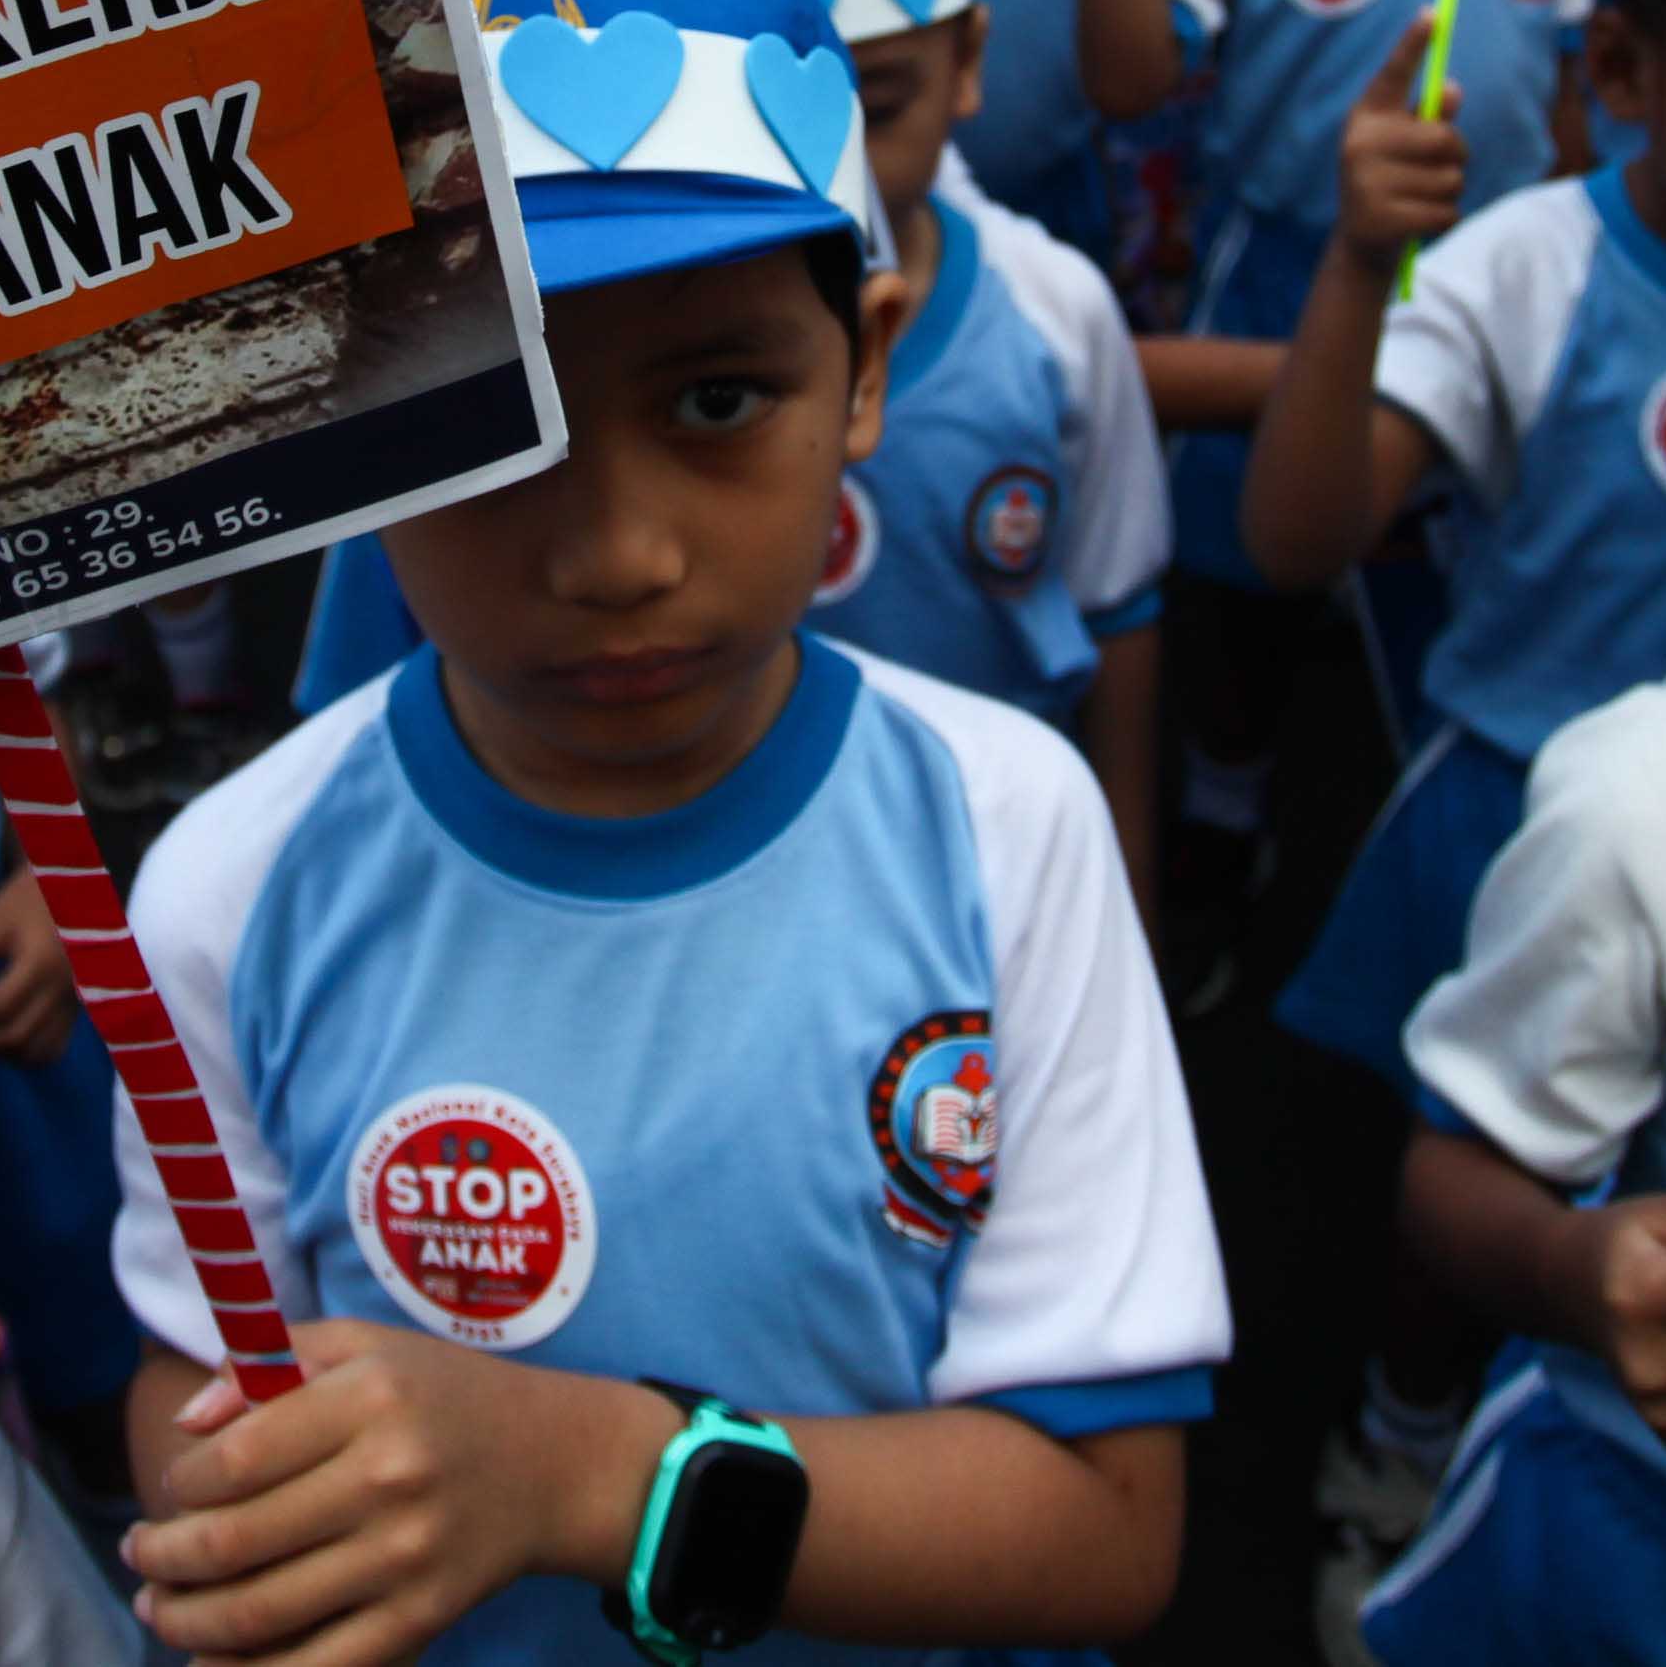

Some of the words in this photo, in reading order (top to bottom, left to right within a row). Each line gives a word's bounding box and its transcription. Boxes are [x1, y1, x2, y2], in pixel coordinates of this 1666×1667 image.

[85, 499, 156, 537] 29.
[10, 560, 70, 603] 65
[80, 541, 139, 582] 36
[147, 518, 204, 561] 54
[213, 494, 284, 541] 56.
[384, 1162, 550, 1222] STOP
[418, 1236, 530, 1276] ANAK
